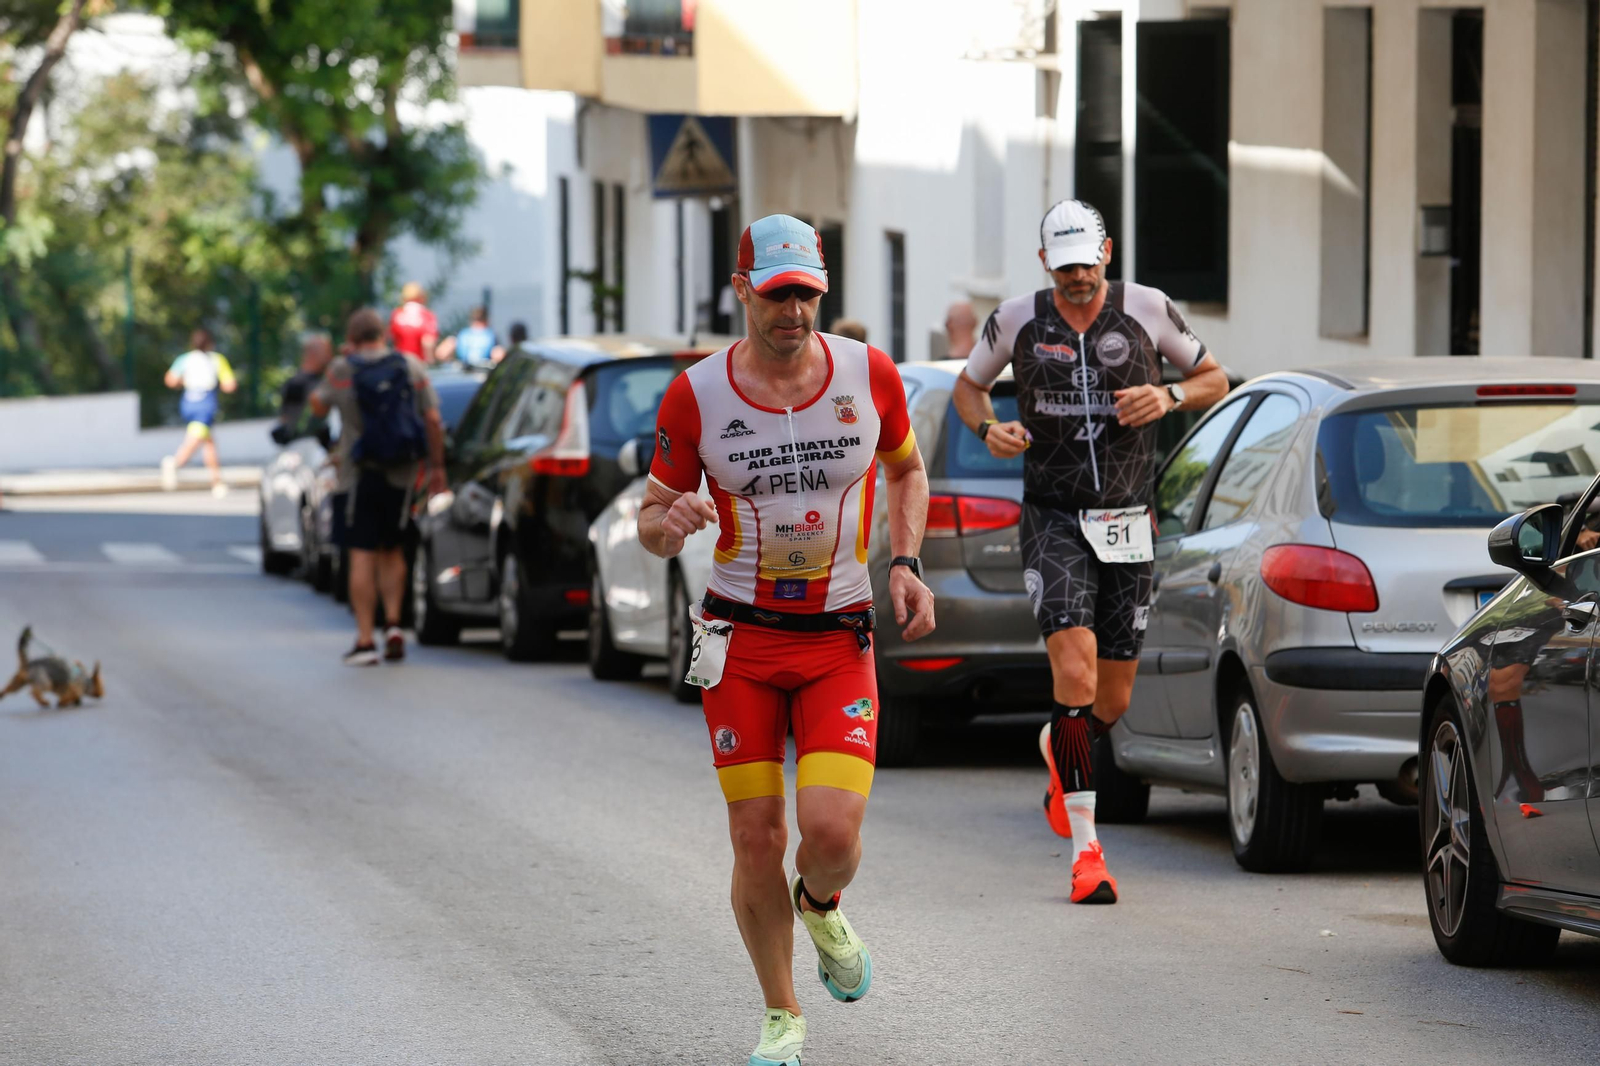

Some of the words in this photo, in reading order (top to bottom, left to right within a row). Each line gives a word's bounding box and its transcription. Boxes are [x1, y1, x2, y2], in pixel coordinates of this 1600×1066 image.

[728, 447, 773, 463] CLUB
[778, 436, 861, 454] TRIATLÓN
[747, 450, 846, 471] ALGECIRAS
[769, 465, 829, 495] PEÑA
[775, 522, 824, 533] MHBland
[1106, 523, 1131, 546] 51
[1362, 622, 1438, 634] PEUGEOT
